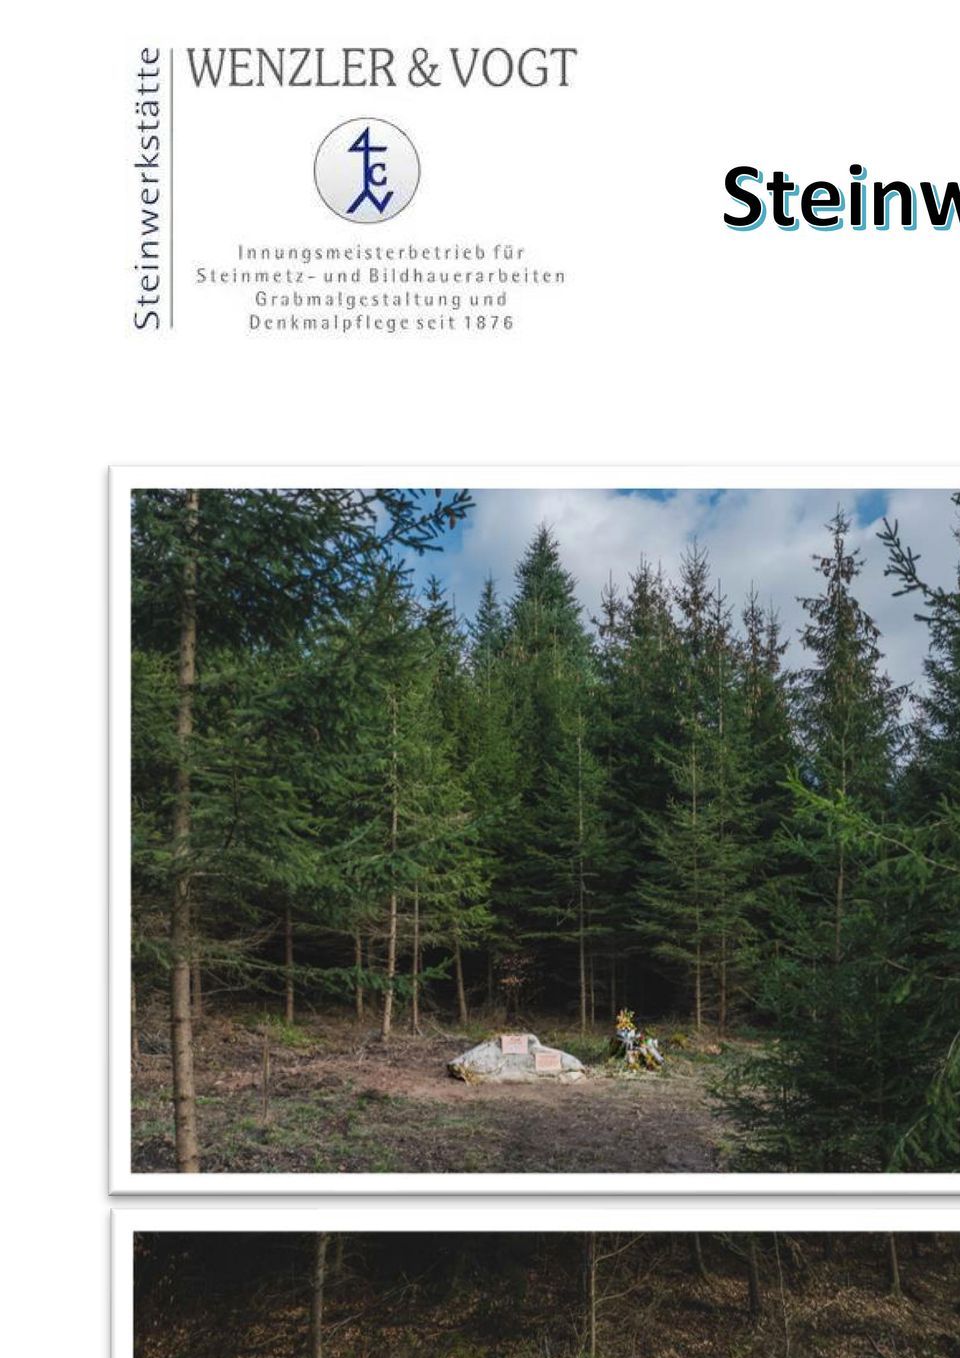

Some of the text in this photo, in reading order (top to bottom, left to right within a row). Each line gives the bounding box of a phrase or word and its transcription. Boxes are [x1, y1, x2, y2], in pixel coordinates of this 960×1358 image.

[187, 47, 578, 88] WENZLER & VOGT
[133, 47, 160, 330] Steinwerkstätte
[238, 244, 524, 264] Innungsmeisterbetrieb für
[197, 268, 565, 284] Steinmetz- und Bildhauerarbeiten
[255, 291, 507, 311] Grabmalgestaltung und
[249, 314, 514, 334] Denkmalpflege seit 1876
